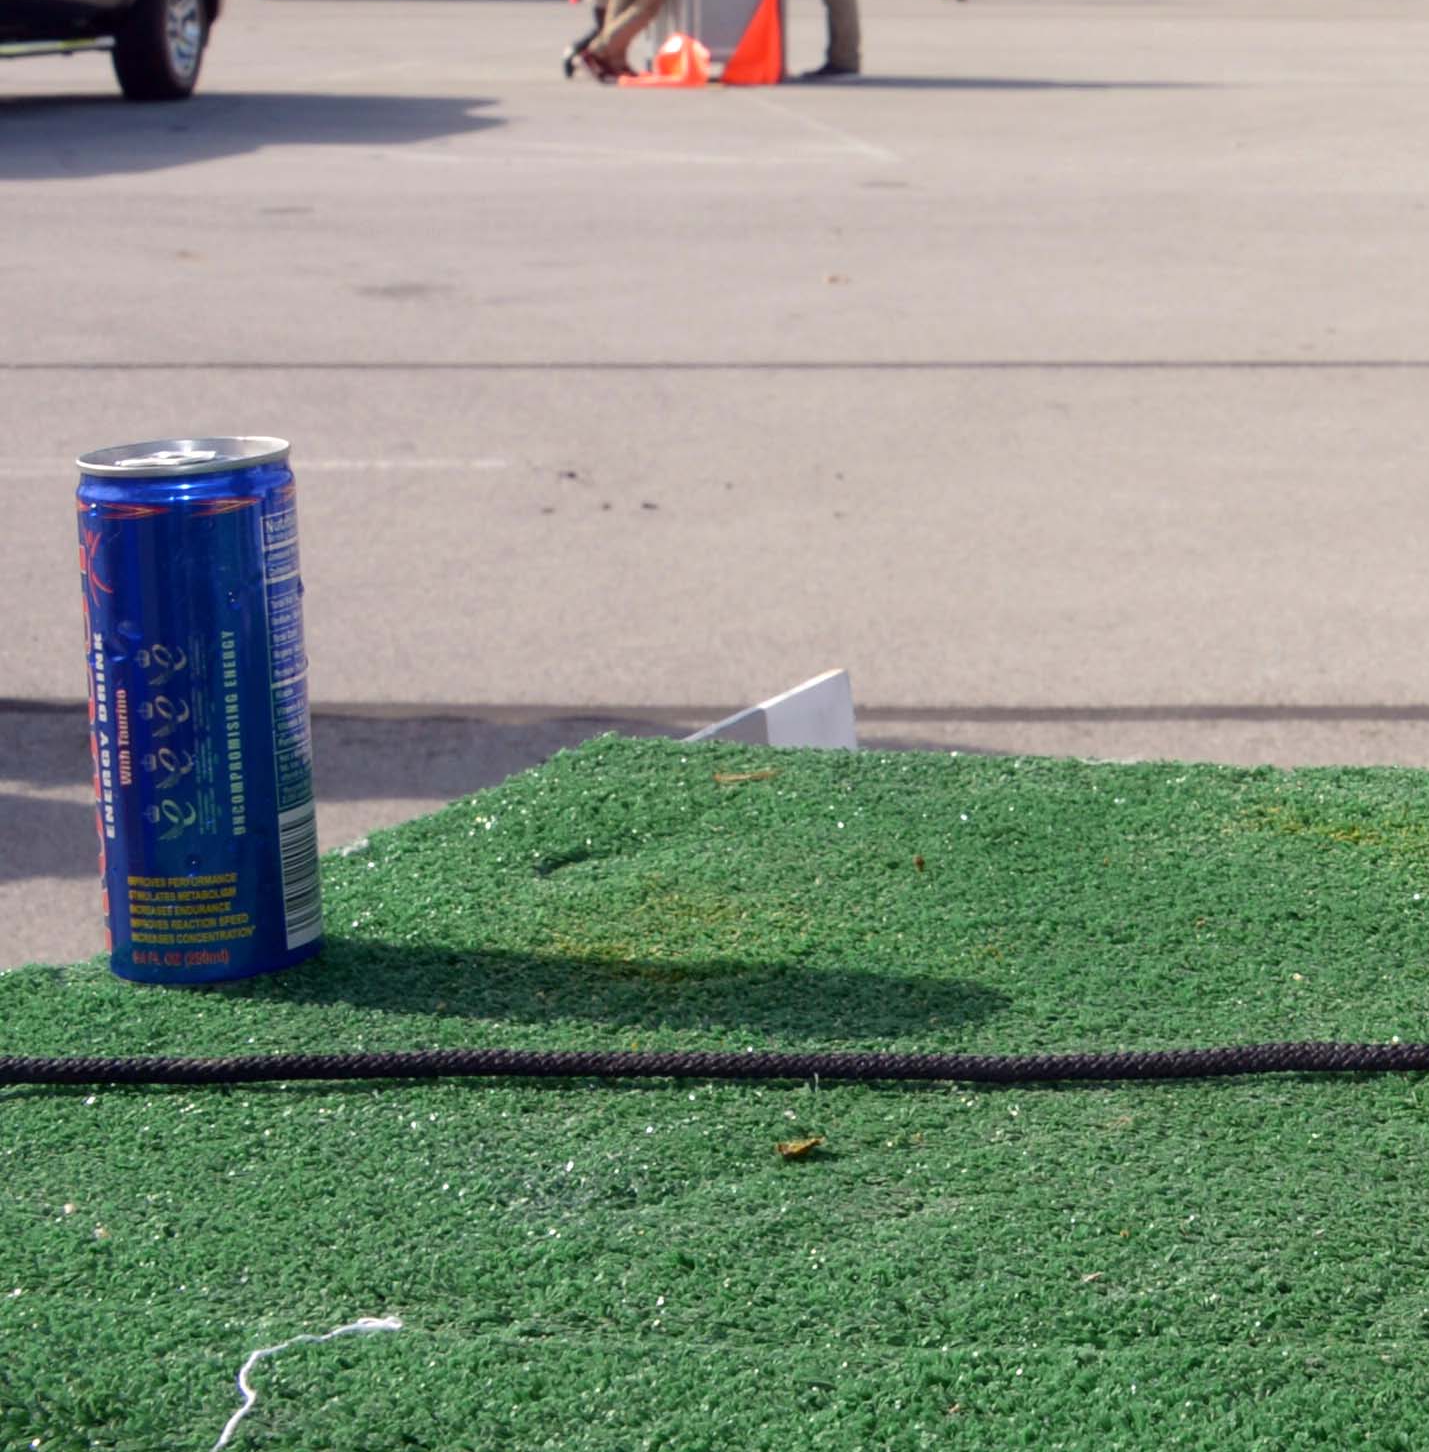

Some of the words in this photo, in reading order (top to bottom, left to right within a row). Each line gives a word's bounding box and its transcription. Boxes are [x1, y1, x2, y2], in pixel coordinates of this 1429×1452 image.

[93, 632, 108, 723] DRINK
[220, 630, 238, 688] ENERGY
[115, 688, 130, 747] Taurine
[99, 731, 117, 839] ENERGY
[119, 751, 133, 787] With
[224, 693, 246, 836] UNCOMPROMISING
